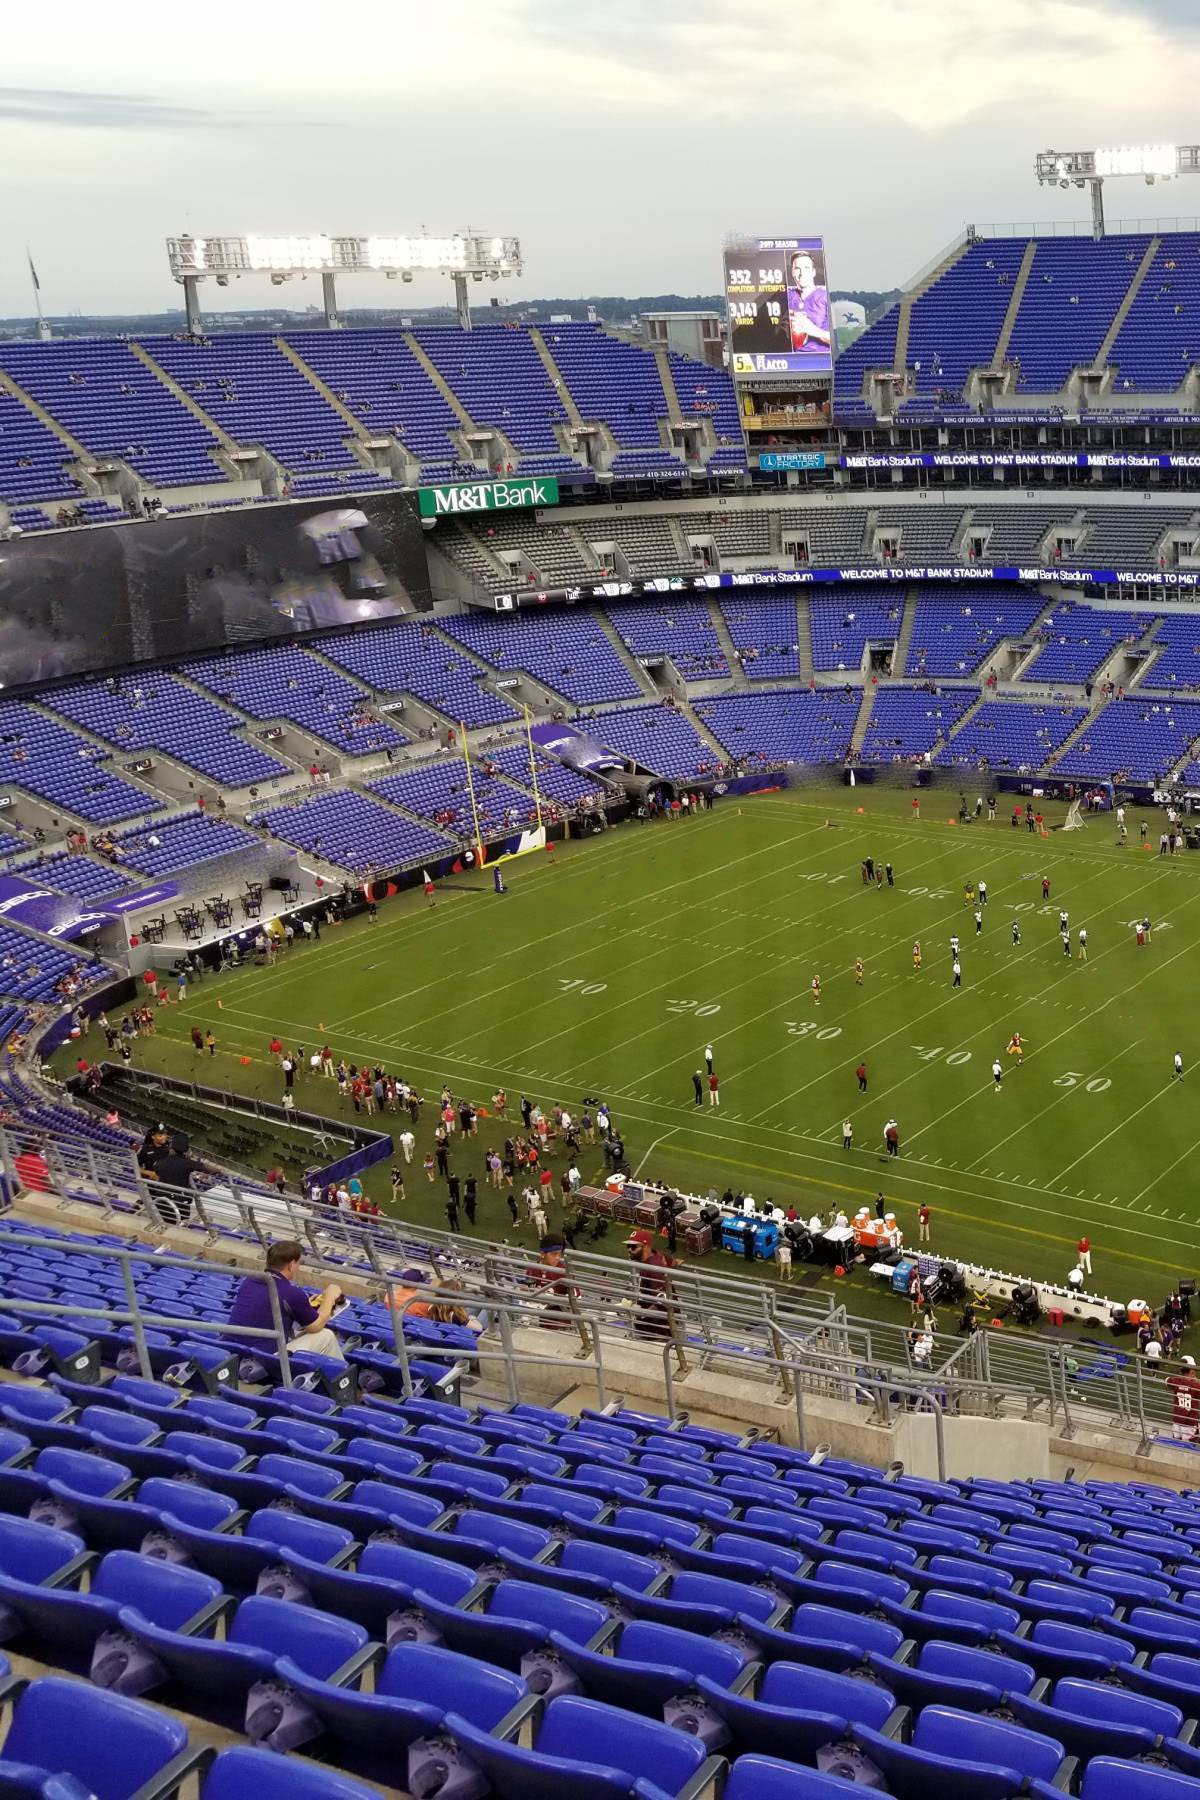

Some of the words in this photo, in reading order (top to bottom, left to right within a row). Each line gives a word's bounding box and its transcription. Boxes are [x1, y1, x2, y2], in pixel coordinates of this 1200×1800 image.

[774, 240, 798, 248] SEASON
[729, 269, 751, 285] 352
[759, 269, 782, 284] 549
[758, 284, 785, 292] ATTEMPTS
[766, 301, 781, 317] 18
[735, 317, 754, 325] YARDS
[770, 317, 779, 325] TD
[736, 356, 744, 370] 5
[756, 357, 788, 370] FLACCO
[776, 460, 820, 468] FACTORY
[846, 457, 868, 466] M&T
[868, 457, 889, 466] Bank
[889, 457, 922, 465] Stadium
[934, 456, 979, 464] WELCOME
[981, 456, 992, 464] TO
[995, 456, 1014, 464] M&T
[1015, 456, 1039, 464] BANK
[1040, 456, 1078, 464] STADIUM
[1088, 455, 1107, 465] M&T
[1107, 456, 1127, 465] Bank
[1127, 456, 1159, 465] Stadium
[646, 470, 688, 478] 410-324-6141
[433, 484, 491, 513] M&T
[493, 481, 548, 508] Bank
[732, 574, 755, 584] M&T
[755, 574, 777, 583] Bank
[777, 573, 813, 582] Stadium
[840, 570, 888, 578] WELCOME
[890, 569, 903, 577] TO
[905, 569, 926, 577] M&T
[927, 569, 952, 577] BANK
[953, 569, 993, 577] STADIUM
[1019, 569, 1040, 579] M&T
[1040, 570, 1059, 579] Bank
[1060, 571, 1093, 580] Stadium
[1116, 573, 1162, 582] WELCOME
[1164, 574, 1177, 582] TO
[1178, 575, 1199, 583] M&T
[909, 886, 956, 899] 20
[0, 890, 52, 914] GEICO
[1013, 902, 1061, 915] 30
[47, 912, 107, 936] GEICO
[81, 923, 100, 934] GEICO
[564, 978, 608, 996] 10
[675, 999, 722, 1018] 20
[787, 1021, 843, 1041] 30
[921, 1046, 973, 1066] 40
[1052, 1071, 1112, 1093] 50
